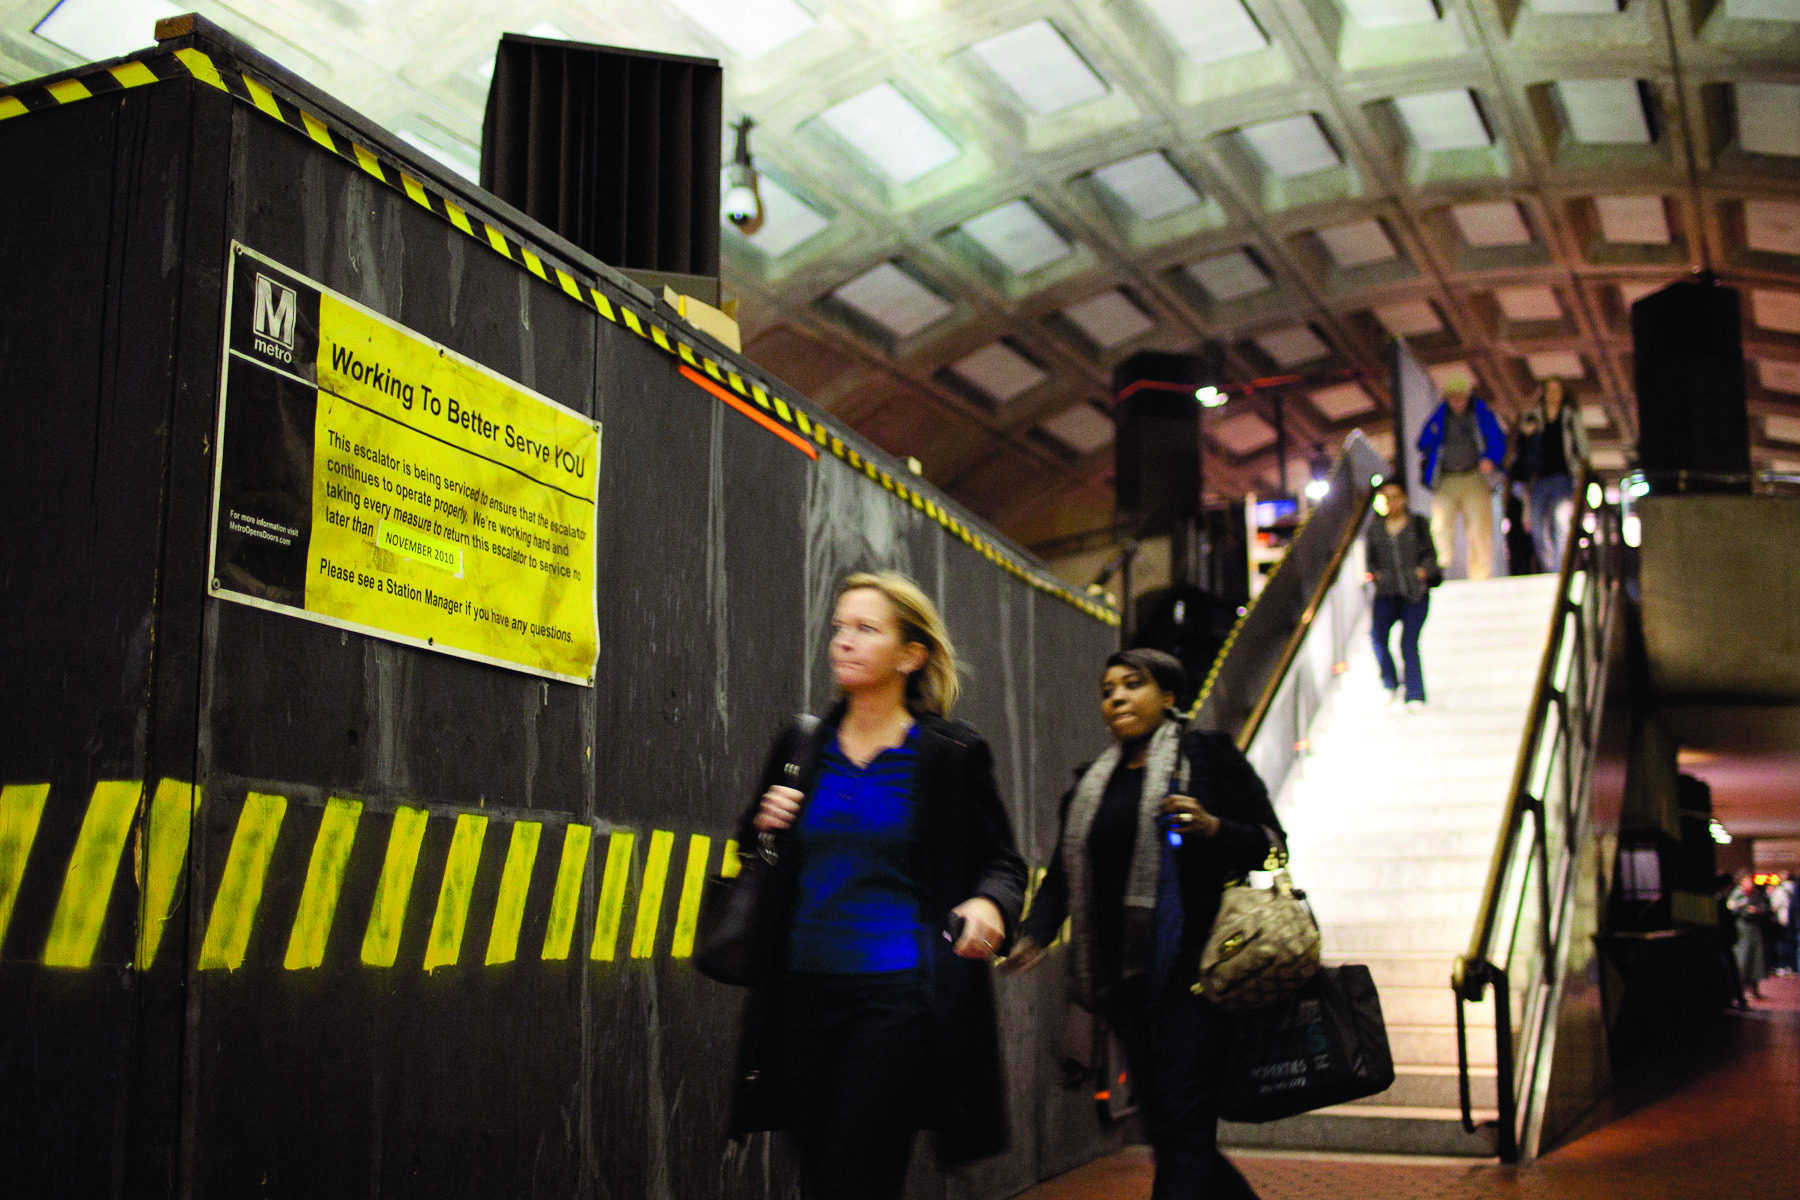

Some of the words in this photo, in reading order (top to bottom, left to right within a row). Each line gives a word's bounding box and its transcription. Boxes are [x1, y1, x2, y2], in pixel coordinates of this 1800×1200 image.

[256, 276, 295, 345] M
[254, 338, 292, 364] metro
[332, 343, 414, 410] Working
[421, 384, 441, 416] To
[448, 397, 500, 441] Better
[505, 424, 550, 463] Serve
[555, 445, 585, 478] YOU
[327, 459, 380, 488] continues
[382, 476, 393, 492] to
[395, 484, 432, 507] operate
[434, 497, 468, 524] properly.
[473, 509, 497, 532] We're
[498, 523, 532, 548] working
[533, 532, 551, 552] hard
[552, 543, 569, 557] and
[328, 429, 351, 453] This
[353, 443, 401, 472] escalator
[402, 459, 411, 476] is
[414, 463, 441, 490] being
[443, 478, 481, 502] serviced
[481, 490, 488, 506] to
[489, 497, 517, 517] ensure
[519, 506, 536, 524] that
[537, 512, 549, 529] the
[550, 520, 586, 541] escalator
[229, 509, 240, 520] For
[241, 514, 256, 524] more
[256, 516, 287, 534] information
[287, 527, 299, 537] visit
[229, 521, 291, 546] MetroOpensDoors.com
[325, 505, 351, 529] later
[351, 516, 374, 537] than
[326, 481, 361, 510] taking
[363, 497, 392, 520] every
[393, 506, 432, 532] measure
[433, 520, 443, 536] to
[443, 525, 470, 546] return
[472, 534, 490, 552] this
[491, 542, 527, 566] escalator
[528, 554, 538, 569] to
[539, 560, 571, 578] service
[385, 532, 432, 557] NOVEMBER
[434, 549, 454, 565] 2010
[320, 557, 355, 584] Please
[357, 572, 375, 589] see
[377, 579, 383, 592] a
[386, 578, 422, 603] Station
[424, 588, 463, 615] Manager
[465, 600, 472, 616] if
[473, 605, 489, 621] you
[491, 608, 509, 627] have
[511, 618, 528, 636] any
[530, 623, 574, 643] questions.
